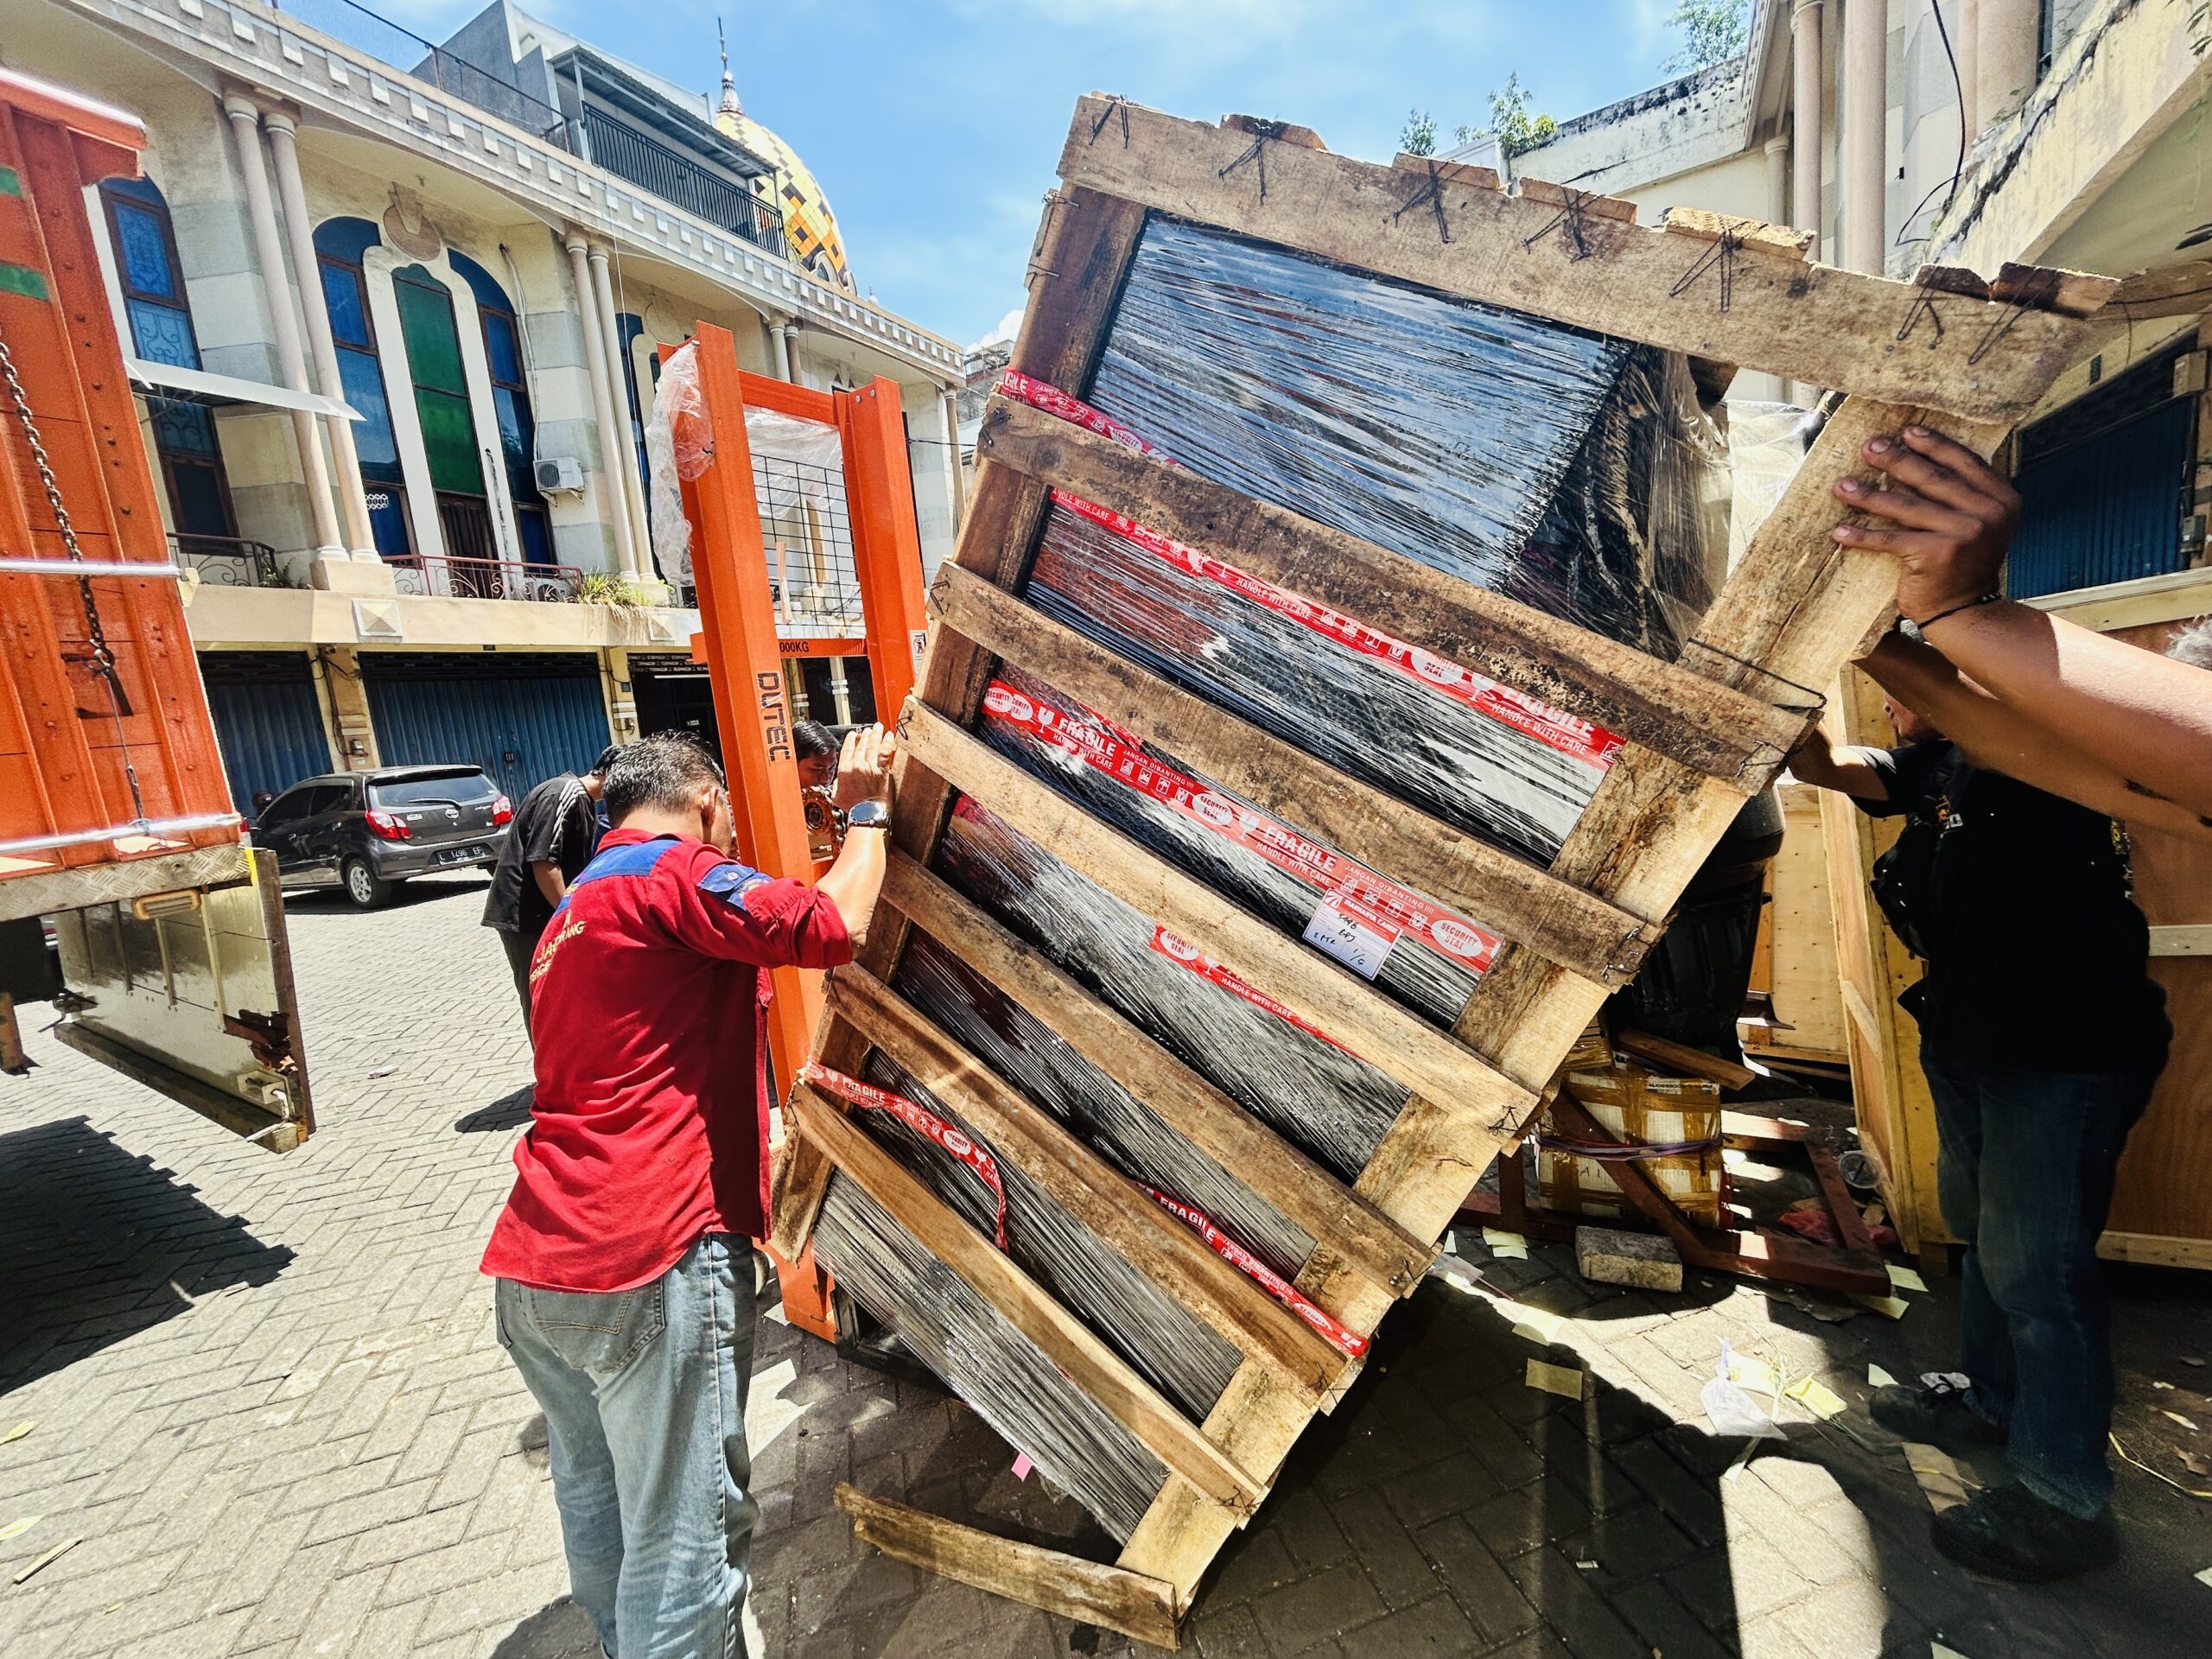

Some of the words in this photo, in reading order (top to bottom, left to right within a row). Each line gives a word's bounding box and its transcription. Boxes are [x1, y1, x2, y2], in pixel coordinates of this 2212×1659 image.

[1052, 488, 1073, 504] ANDLE
[1074, 498, 1090, 512] WITH
[1091, 505, 1110, 521] CARE
[1236, 578, 1268, 598] HANDLE
[1268, 593, 1288, 608] WITH
[1289, 602, 1312, 620] CARE
[779, 641, 810, 652] 000KG
[1423, 662, 1445, 678] SEAL
[1491, 702, 1532, 728] HANDLE
[1533, 721, 1559, 741] WITH
[1559, 734, 1588, 754] CARE
[1500, 687, 1596, 738] FRAGILE
[1058, 718, 1117, 757] FRAGILE
[1096, 755, 1114, 771] CARE
[1123, 748, 1148, 766] JANGAN
[1149, 762, 1186, 785] DIBANTING
[1256, 842, 1287, 862] HANDLE
[1287, 857, 1309, 875] WITH
[1309, 869, 1332, 887] CARE
[1264, 825, 1338, 872] FRAGILE
[1344, 865, 1376, 885] JANGAN
[1378, 882, 1424, 909] DIBANTING
[1170, 942, 1185, 955] SEAL
[1440, 922, 1478, 945] SECURITY
[1444, 934, 1464, 950] SEAL
[1221, 976, 1251, 996] HANDLE
[1251, 992, 1272, 1008] WITH
[1272, 1002, 1293, 1019] CARE
[842, 1077, 886, 1104] FRAGILE
[1160, 1196, 1217, 1243] FRAGILE
[1222, 1237, 1249, 1262] JANGAN
